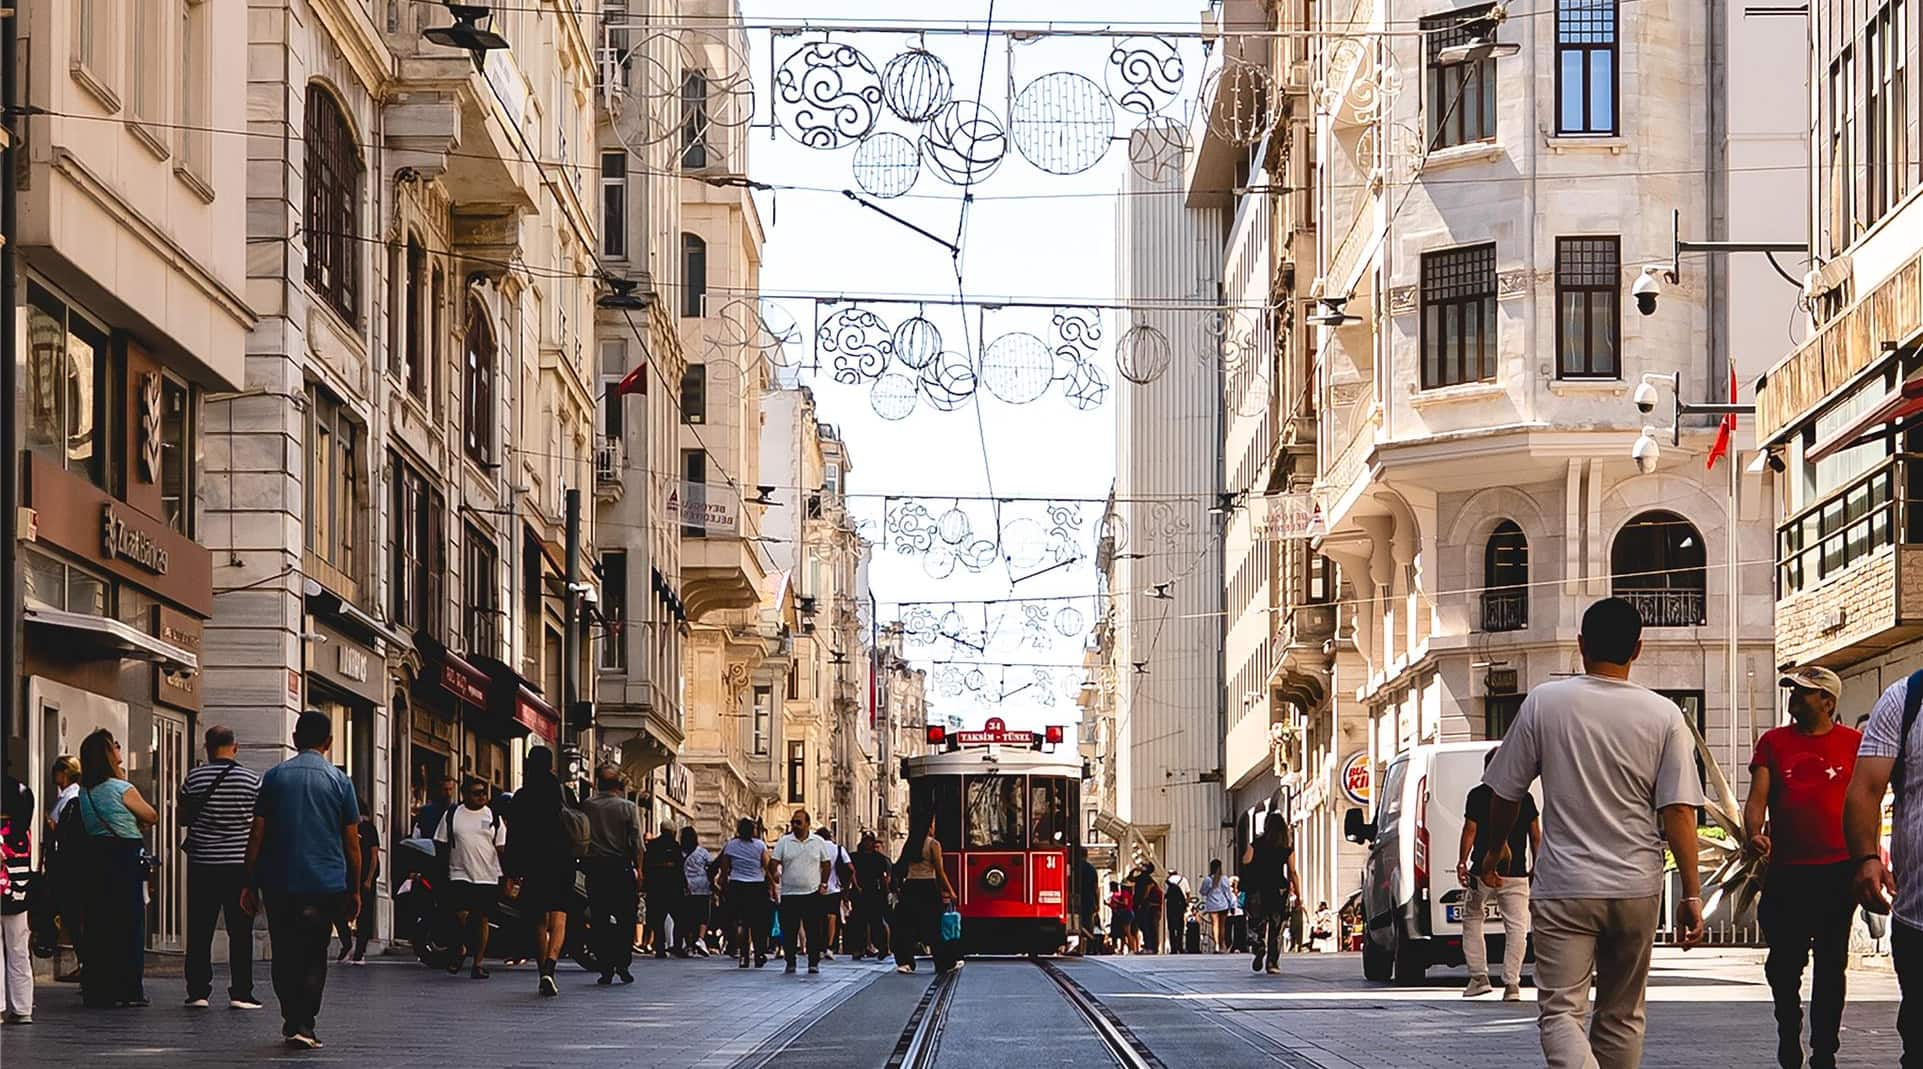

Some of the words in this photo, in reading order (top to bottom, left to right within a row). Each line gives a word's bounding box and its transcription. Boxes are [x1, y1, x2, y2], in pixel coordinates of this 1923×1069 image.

[961, 732, 994, 741] TAKSİM
[1002, 732, 1030, 741] TÜNEL
[1349, 766, 1368, 777] BU
